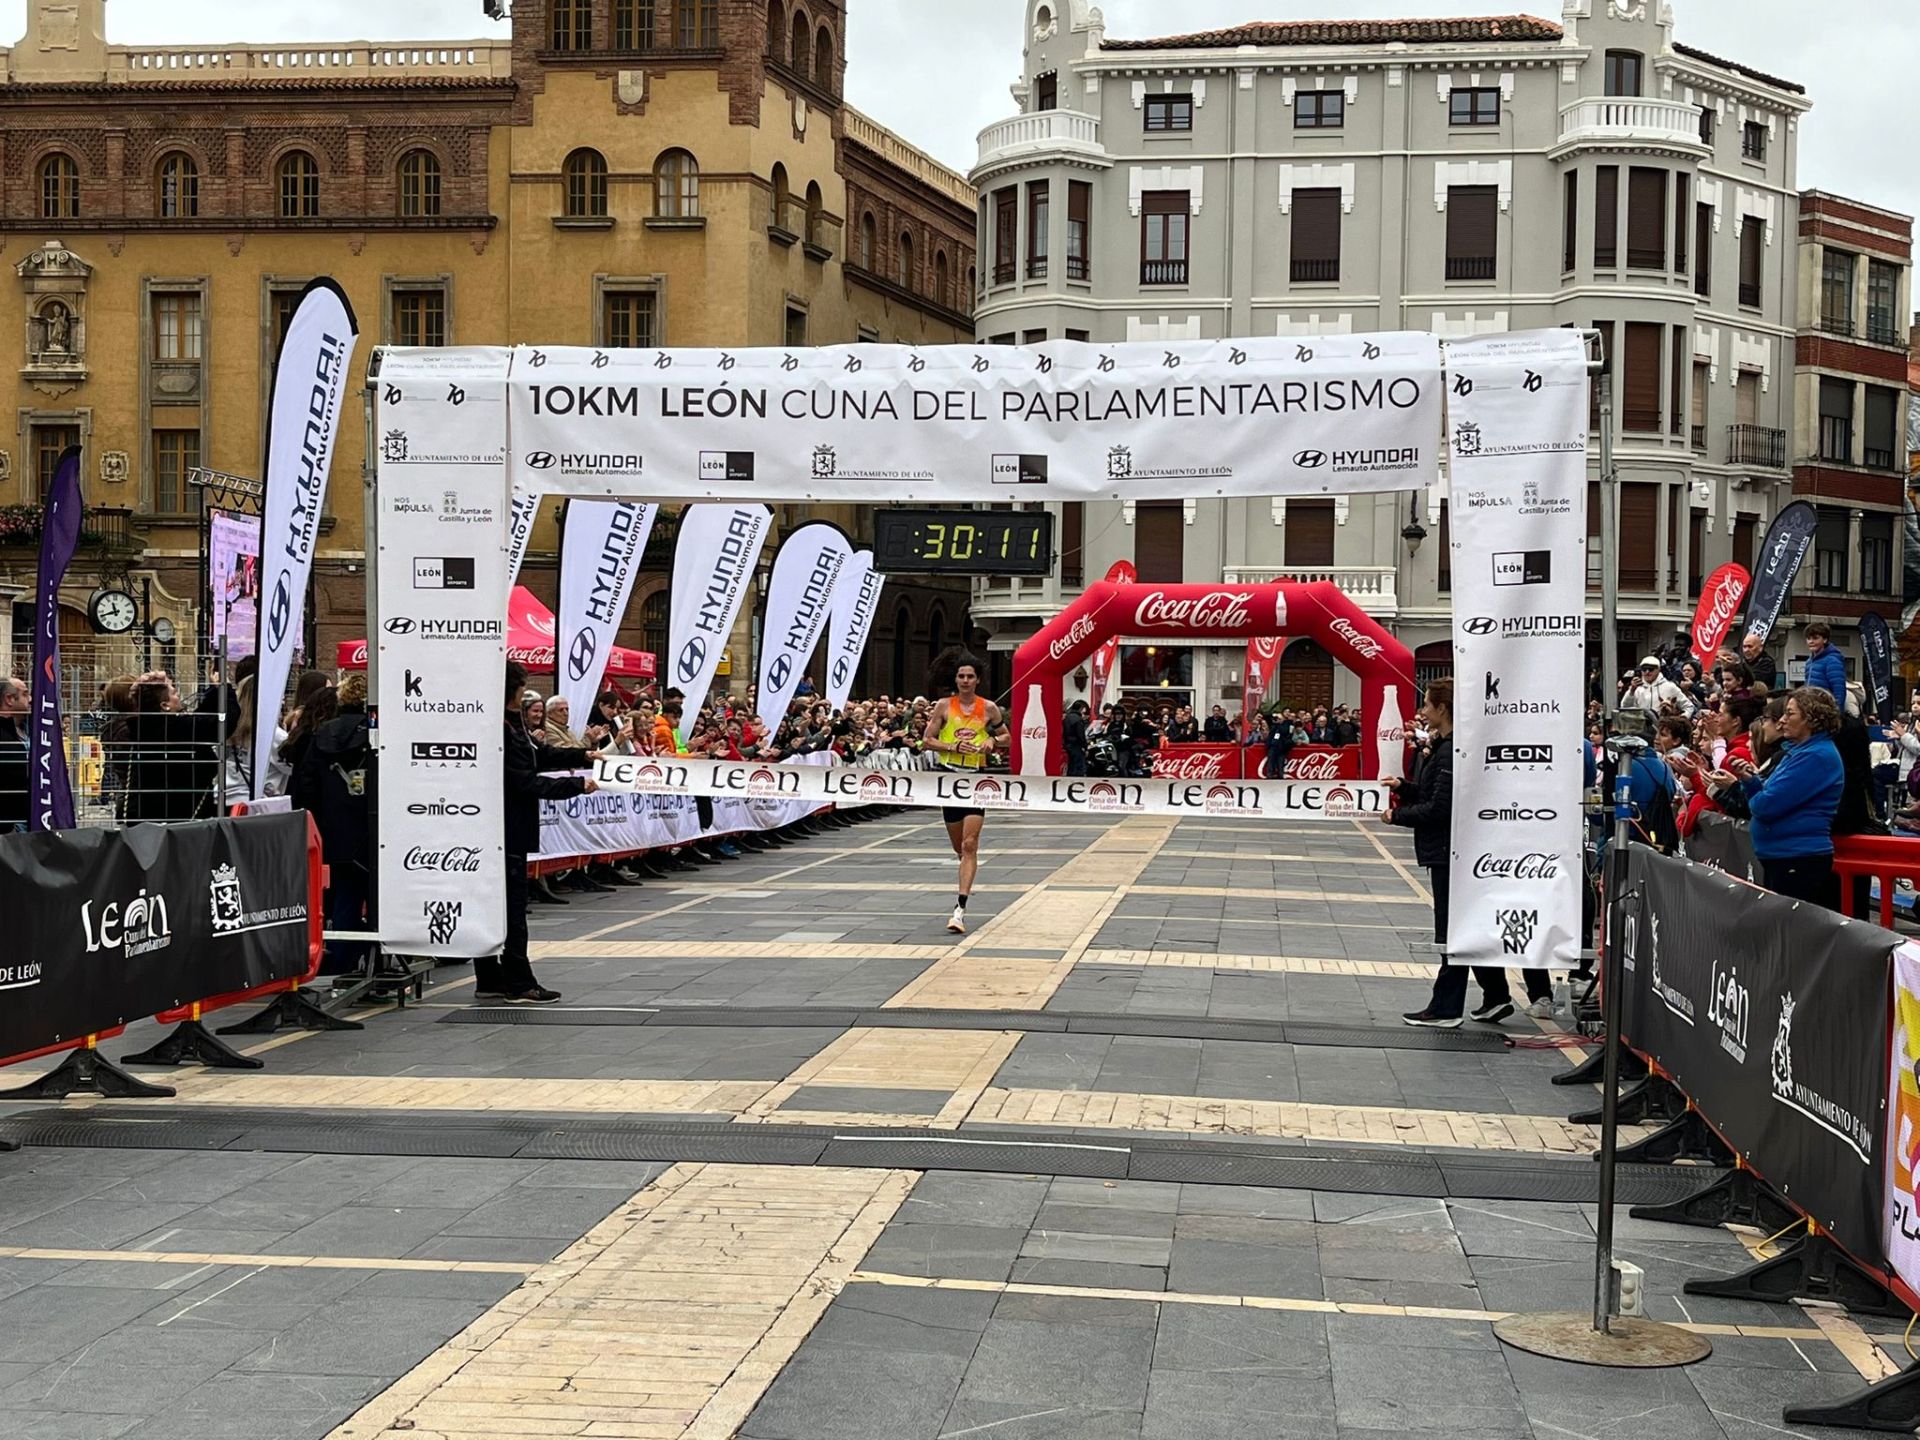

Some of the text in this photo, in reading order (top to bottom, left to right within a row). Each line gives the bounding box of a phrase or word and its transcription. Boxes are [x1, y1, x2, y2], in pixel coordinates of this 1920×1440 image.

[316, 342, 346, 471] Automoción
[529, 378, 1420, 422] 10KM LEÓN CUNA DEL PARLAMENTARISMO
[286, 333, 338, 560] HYUNDAI
[1484, 444, 1550, 454] AYUNTAMIENTO
[1563, 441, 1584, 449] LEÓN
[484, 453, 504, 462] LEÓN
[561, 454, 642, 468] HYUNDAI
[1332, 448, 1418, 464] HYUNDAI
[595, 468, 642, 476] Automoción
[702, 460, 724, 470] LEÓN
[994, 463, 1018, 473] LEÓN
[1134, 468, 1197, 476] AYUNTAMIENTO
[1211, 466, 1232, 474] LEÓN
[1332, 463, 1418, 472] Lemauto Automoción
[838, 470, 899, 478] AYUNTAMIENTO
[914, 470, 934, 478] LEÓN
[394, 504, 434, 514] IMPULSA
[1468, 498, 1512, 508] IMPULSA
[1540, 498, 1558, 506] Junta
[585, 503, 636, 621] HYUND
[1497, 562, 1522, 573] LEÓN
[417, 566, 442, 577] LEÓN
[695, 510, 752, 632] HYUNDAI
[714, 516, 762, 635] Lemauto Automoción
[603, 566, 627, 625] Lemauto
[784, 546, 838, 651] HYUNDAI
[800, 552, 846, 654] Lemauto Automoción
[842, 567, 876, 653] HYUNDAI
[1134, 592, 1257, 628] Coca-Cola
[1697, 572, 1744, 652] Coca-Cola
[421, 620, 502, 633] HYUNDAI
[1502, 616, 1581, 632] HYUNDAI
[1050, 613, 1096, 660] Coca-Cola
[1330, 618, 1384, 660] Coca-Cola
[1530, 630, 1581, 638] Automoción
[404, 699, 484, 713] kutxabank
[1484, 700, 1560, 716] kutxabank
[414, 745, 476, 757] LEON
[1488, 748, 1550, 760] LEON
[40, 694, 54, 831] ALTAFIT
[407, 797, 480, 816] emico
[1478, 802, 1558, 820] emico
[404, 846, 483, 872] Coca-Cola
[1473, 853, 1560, 879] Coca-Cola
[280, 902, 307, 918] DE LEÓN
[18, 960, 42, 980] LEÓN
[1796, 1082, 1852, 1132] AYUNTAMIENTO
[1859, 1122, 1872, 1153] LÓN
